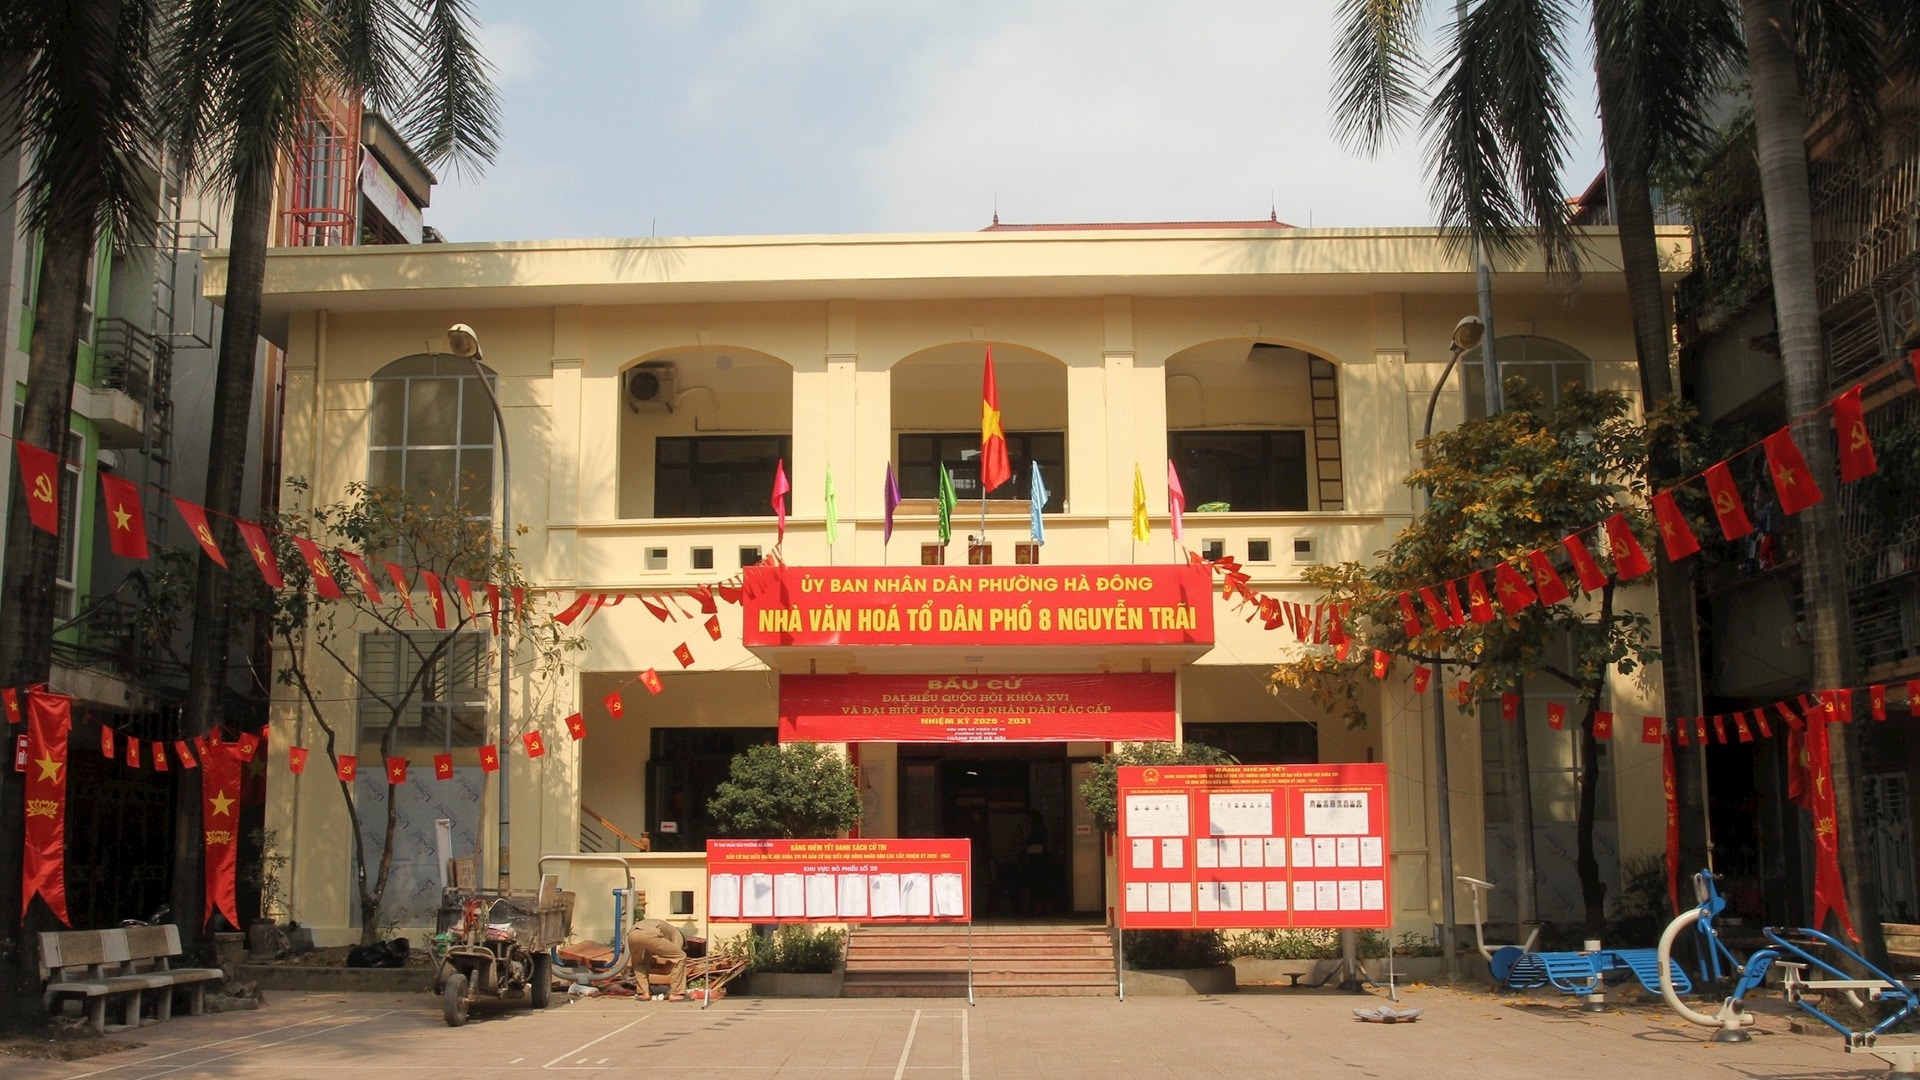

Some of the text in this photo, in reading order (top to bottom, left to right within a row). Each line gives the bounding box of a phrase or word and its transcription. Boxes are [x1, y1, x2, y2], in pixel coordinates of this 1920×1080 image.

[802, 573, 1153, 592] ỦY BAN NHÂN DÂN PHƯỜNG HÀ ĐÔNG
[759, 599, 1196, 632] NHÀ VĂN HOÁ TỔ DÂN PHỐ 8 NGUYỄN TRÃI
[927, 676, 1023, 690] BẦU CỬ
[882, 690, 1069, 703] ĐẠI BIỂU QUỐC HỘI KHÓA XVI
[842, 703, 1111, 716] VÀ ĐẠI BIỂU HỘI ĐỒNG NHÂN DÂN CÁC CẤP
[921, 717, 954, 726] NHIỆM
[957, 716, 970, 725] KỲ
